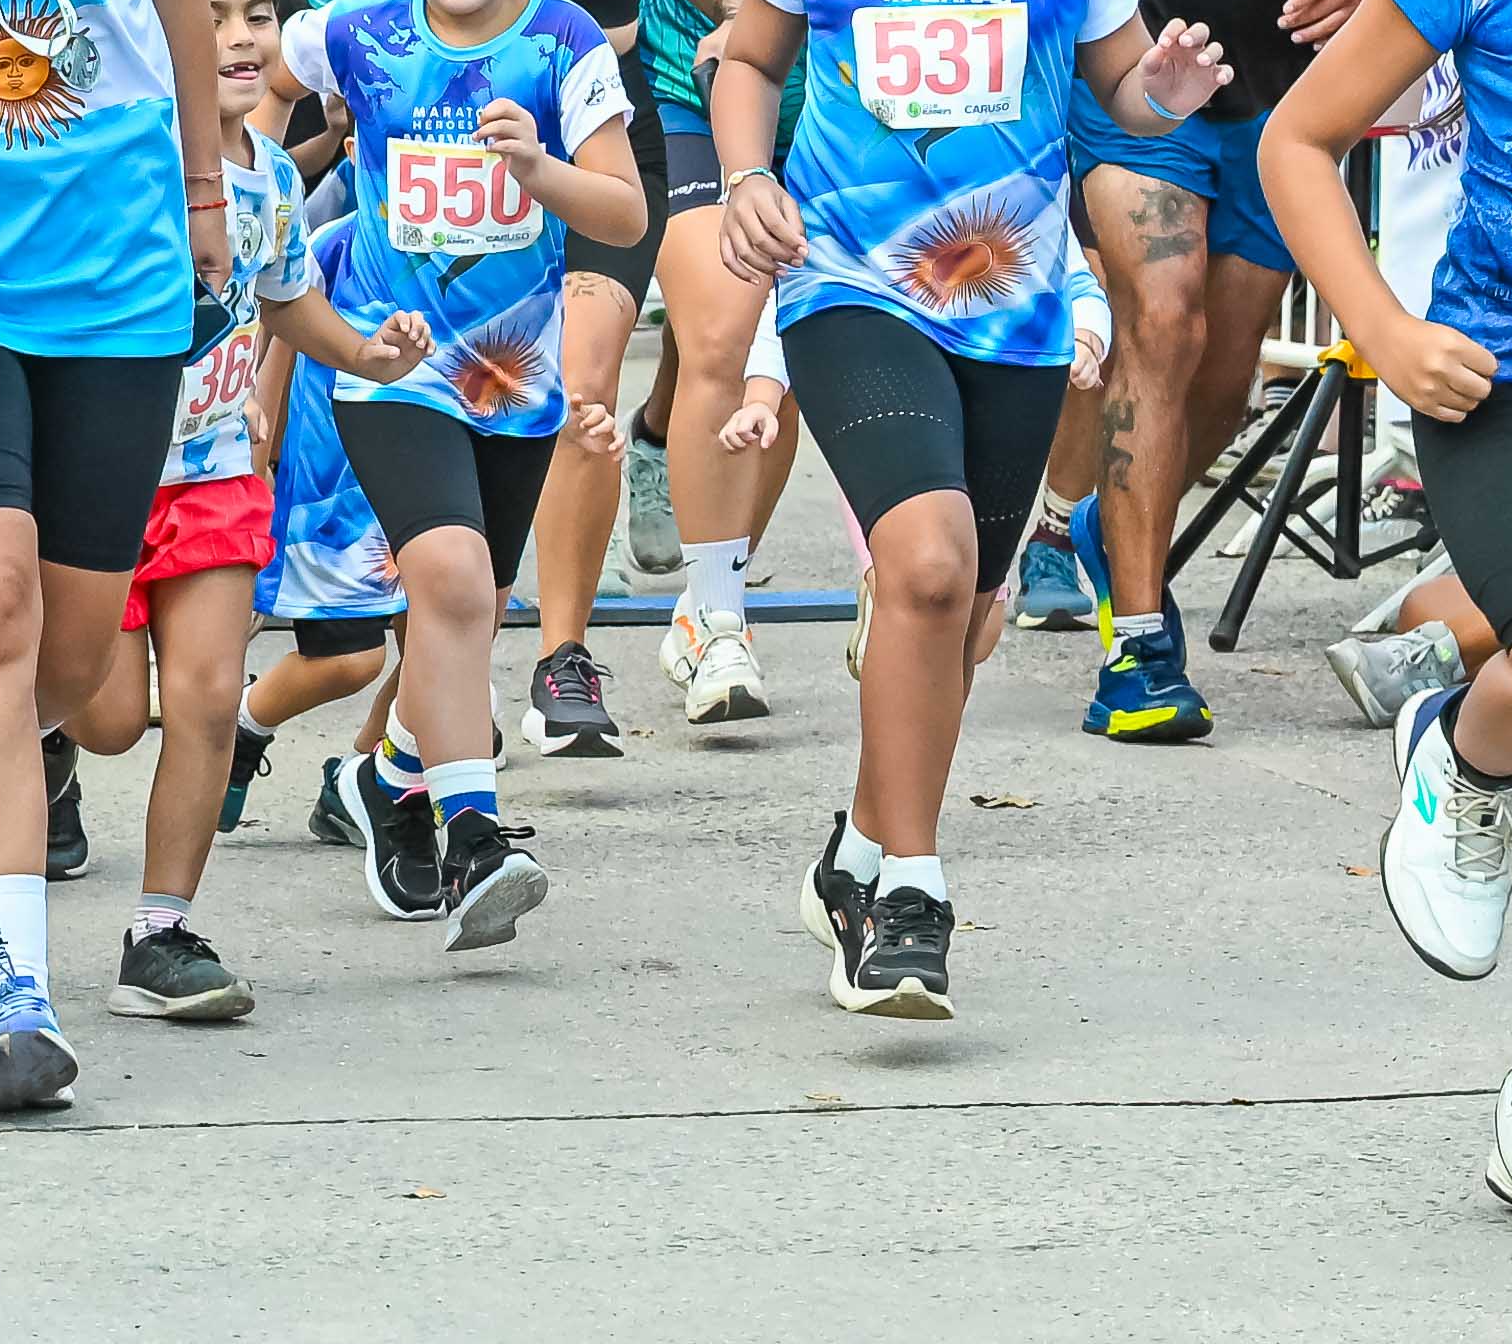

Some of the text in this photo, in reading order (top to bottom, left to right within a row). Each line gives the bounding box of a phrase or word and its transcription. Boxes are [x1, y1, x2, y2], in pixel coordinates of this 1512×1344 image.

[874, 18, 1004, 96] 531
[964, 102, 1010, 114] CARUSO
[399, 153, 532, 227] 550
[485, 232, 530, 243] CARUSO
